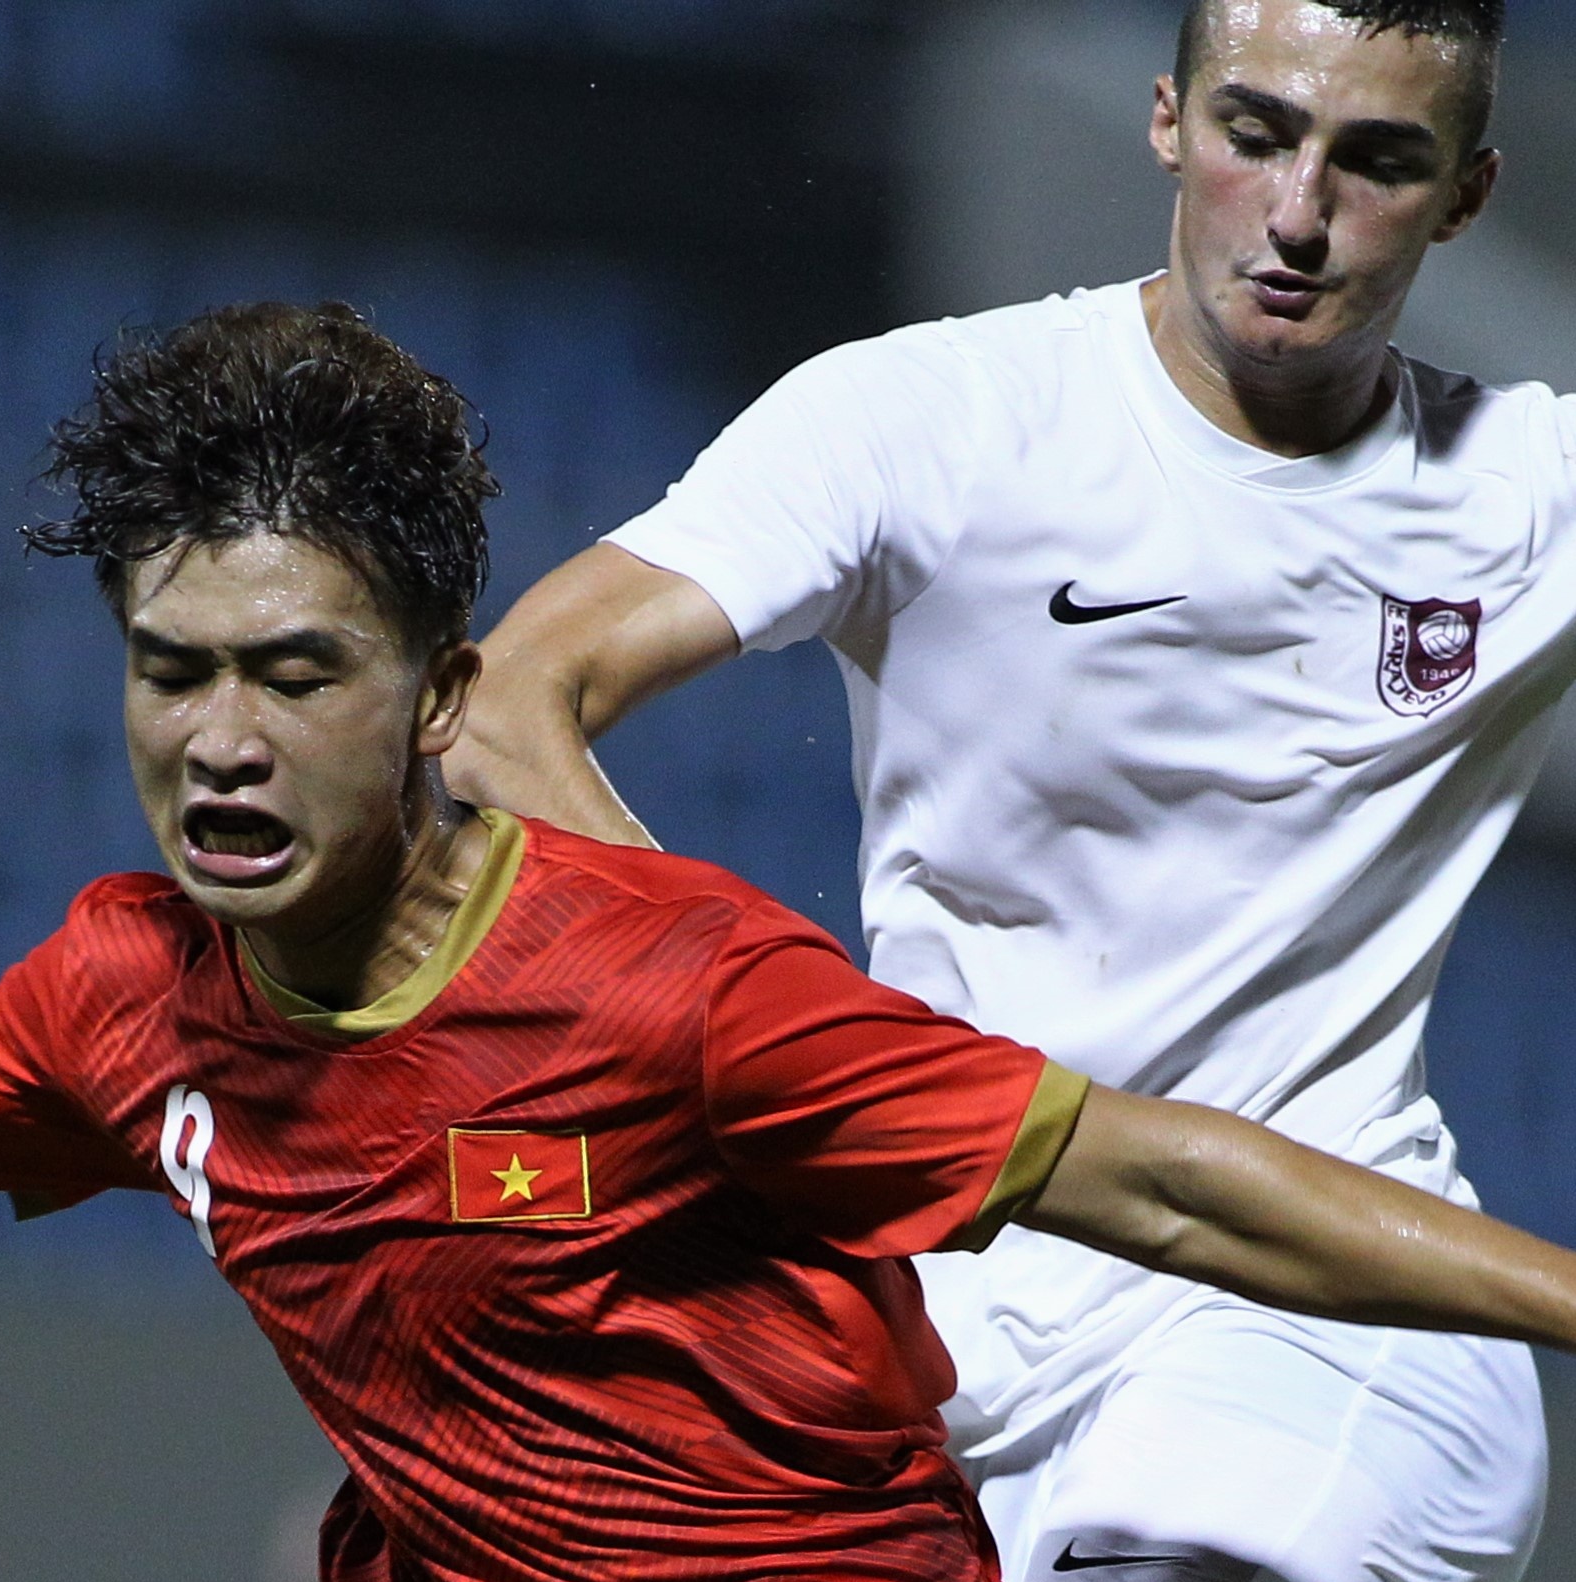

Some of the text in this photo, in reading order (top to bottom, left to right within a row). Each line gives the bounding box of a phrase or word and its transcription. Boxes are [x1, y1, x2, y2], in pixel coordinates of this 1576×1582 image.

[1383, 604, 1446, 705] FK SARAJEVO
[159, 1083, 217, 1259] 9
